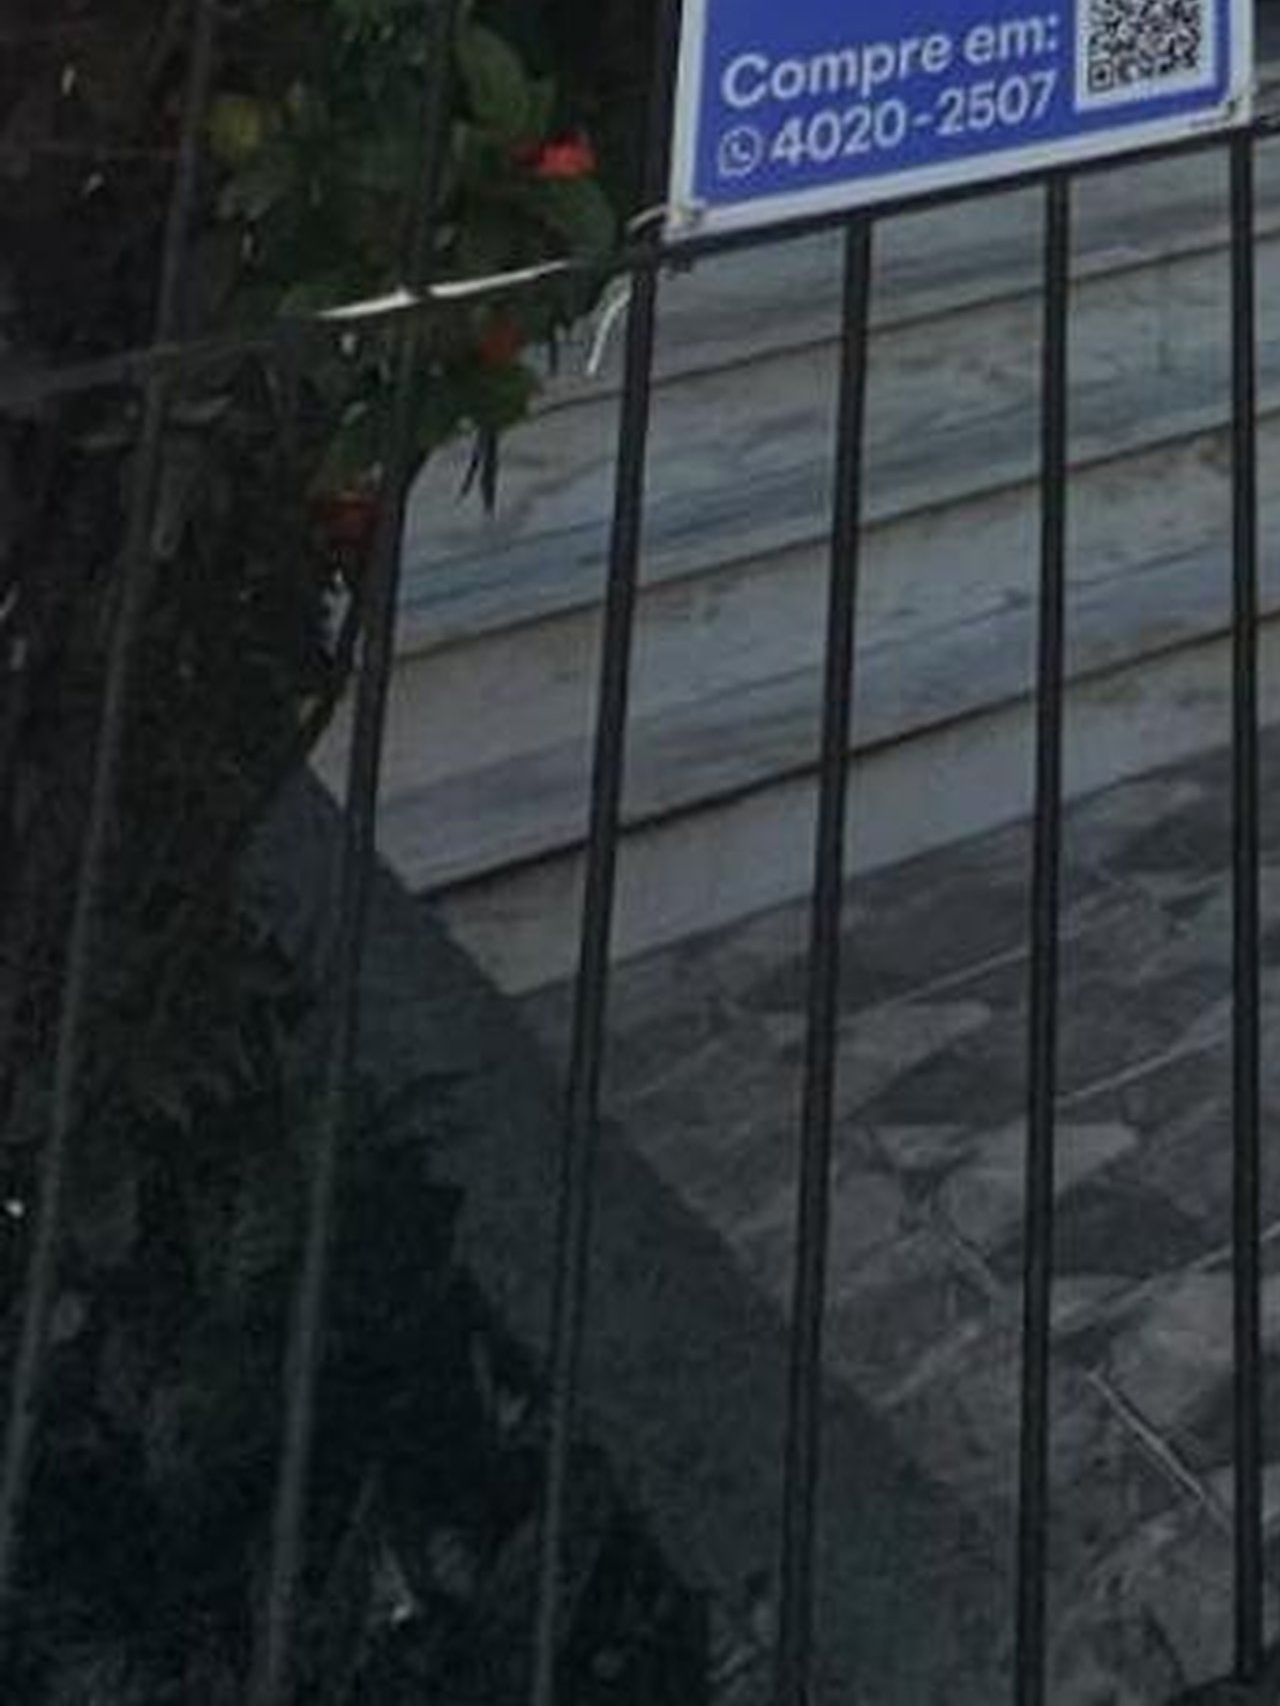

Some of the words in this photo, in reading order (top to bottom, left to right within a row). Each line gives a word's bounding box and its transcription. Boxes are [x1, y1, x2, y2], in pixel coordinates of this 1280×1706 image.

[722, 35, 950, 108] Compre
[965, 12, 1058, 58] em:
[771, 75, 1056, 165] 4020-2507
